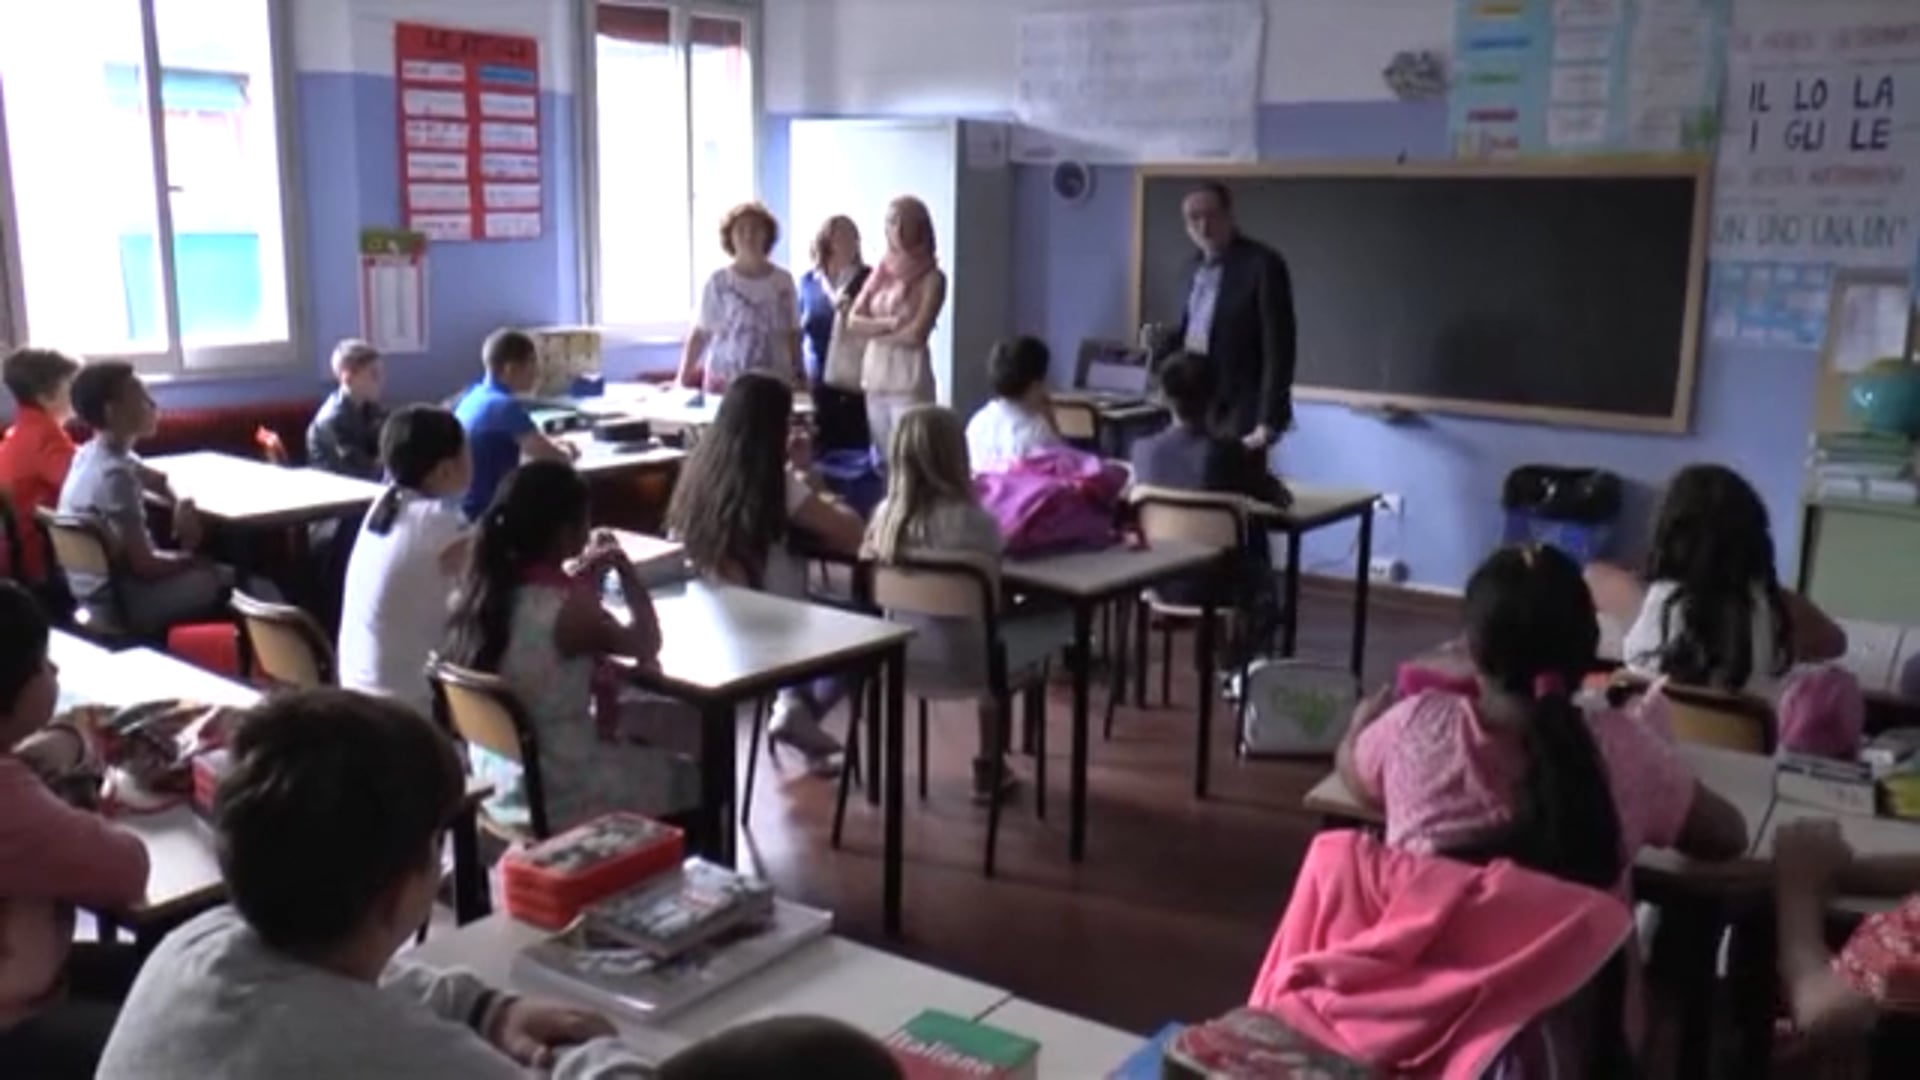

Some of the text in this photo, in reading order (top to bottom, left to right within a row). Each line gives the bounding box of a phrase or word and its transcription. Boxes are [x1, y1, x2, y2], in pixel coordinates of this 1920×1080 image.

[1749, 74, 1894, 112] IL LO LA
[1749, 119, 1759, 153] I
[1850, 117, 1892, 151] LE
[886, 1028, 993, 1075] Italiano
